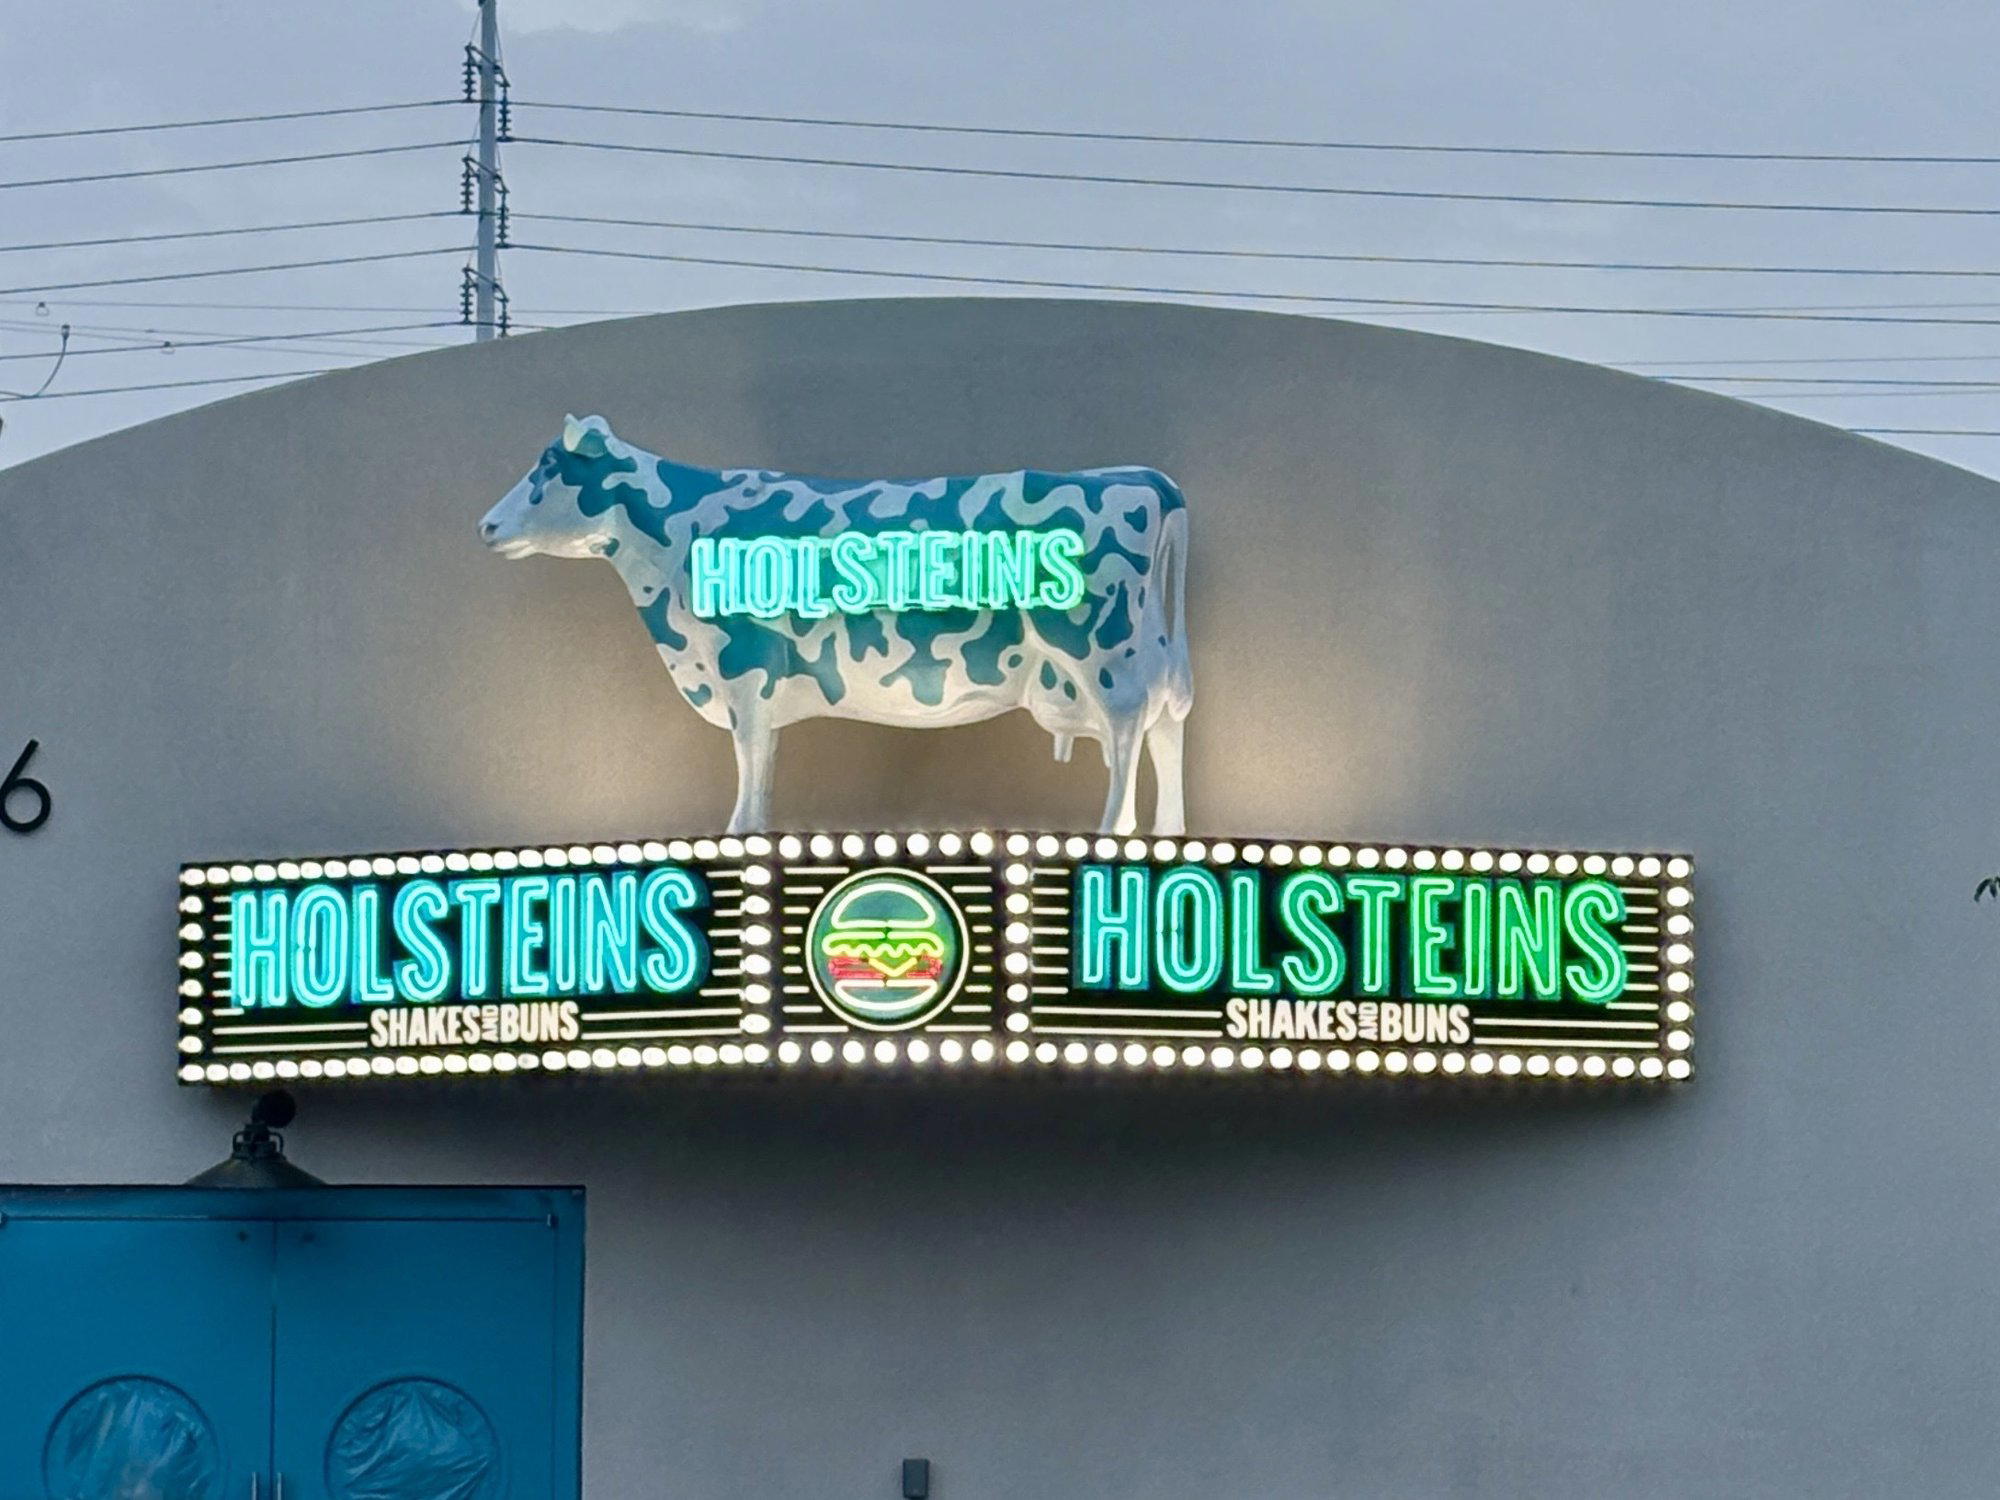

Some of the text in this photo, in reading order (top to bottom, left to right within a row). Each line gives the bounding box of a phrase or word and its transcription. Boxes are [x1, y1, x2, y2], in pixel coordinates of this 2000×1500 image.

[691, 528, 1085, 618] HOLSTEINS
[0, 739, 51, 832] 6
[230, 866, 702, 1009] HOLSTEINS
[1075, 865, 1627, 1003] HOLSTEINS
[370, 1000, 579, 1048] SHAKES AND BUNS
[1226, 998, 1471, 1044] SHAKES AND BUNS
